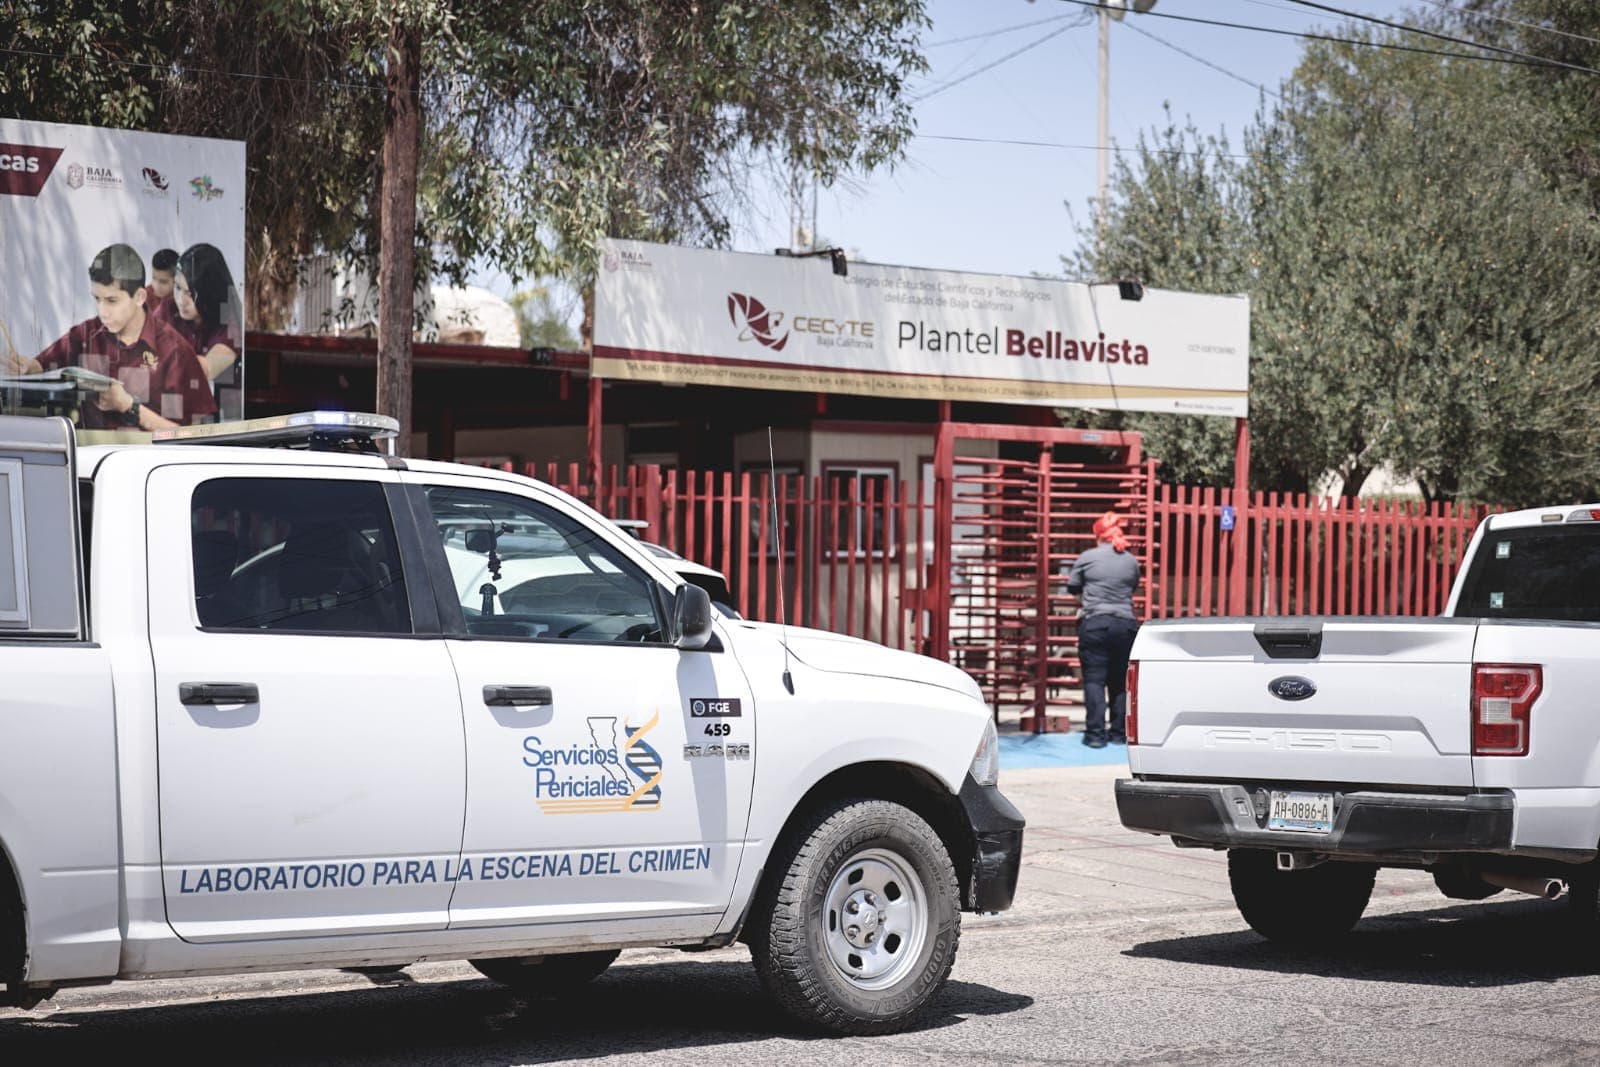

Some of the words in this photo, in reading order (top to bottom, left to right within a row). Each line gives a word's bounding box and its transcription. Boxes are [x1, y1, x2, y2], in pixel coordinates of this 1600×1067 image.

[87, 167, 113, 177] BAJA
[621, 251, 644, 260] BAJA
[881, 277, 894, 287] de
[899, 294, 934, 306] Estado
[936, 297, 948, 307] de
[950, 297, 970, 310] Baja
[971, 299, 1014, 313] California
[898, 320, 999, 356] Plantel
[1006, 328, 1150, 366] Bellavista
[1279, 680, 1304, 695] Ford
[708, 702, 730, 713] FGE
[703, 723, 731, 737] 459
[1203, 729, 1393, 753] F-150
[522, 736, 619, 767] Servicios
[683, 743, 751, 761] RAM
[535, 767, 629, 799] Periciales
[1273, 800, 1328, 821] AH-0886-A
[179, 862, 366, 894] LABORATORIO
[372, 859, 437, 886] PARA
[443, 857, 474, 882] LA
[479, 854, 573, 881] ESCENA
[578, 851, 622, 875] DEL
[628, 847, 711, 873] CRIMEN
